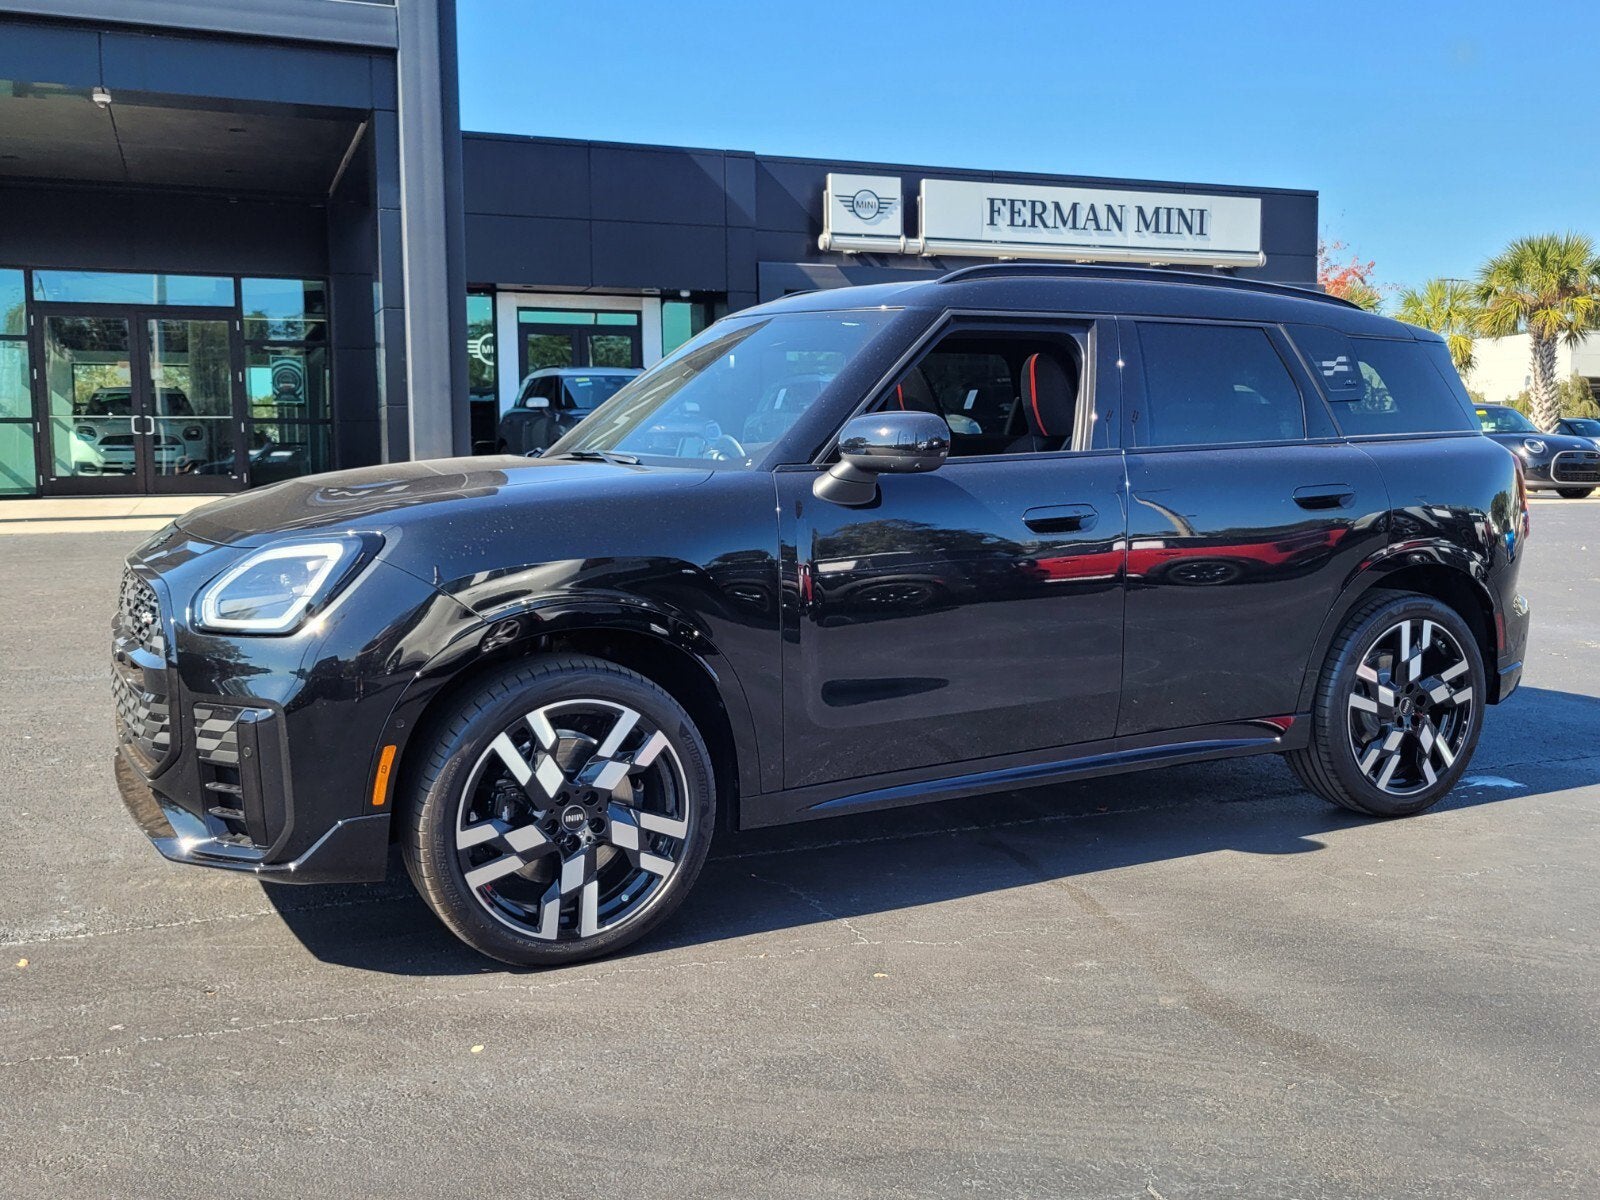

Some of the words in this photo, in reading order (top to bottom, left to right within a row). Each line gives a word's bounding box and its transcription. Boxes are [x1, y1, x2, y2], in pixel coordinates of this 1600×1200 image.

[855, 200, 877, 209] MINI
[986, 197, 1125, 232] FERMAN
[1134, 205, 1209, 236] MINI
[481, 344, 494, 354] MI
[565, 813, 584, 823] MINI
